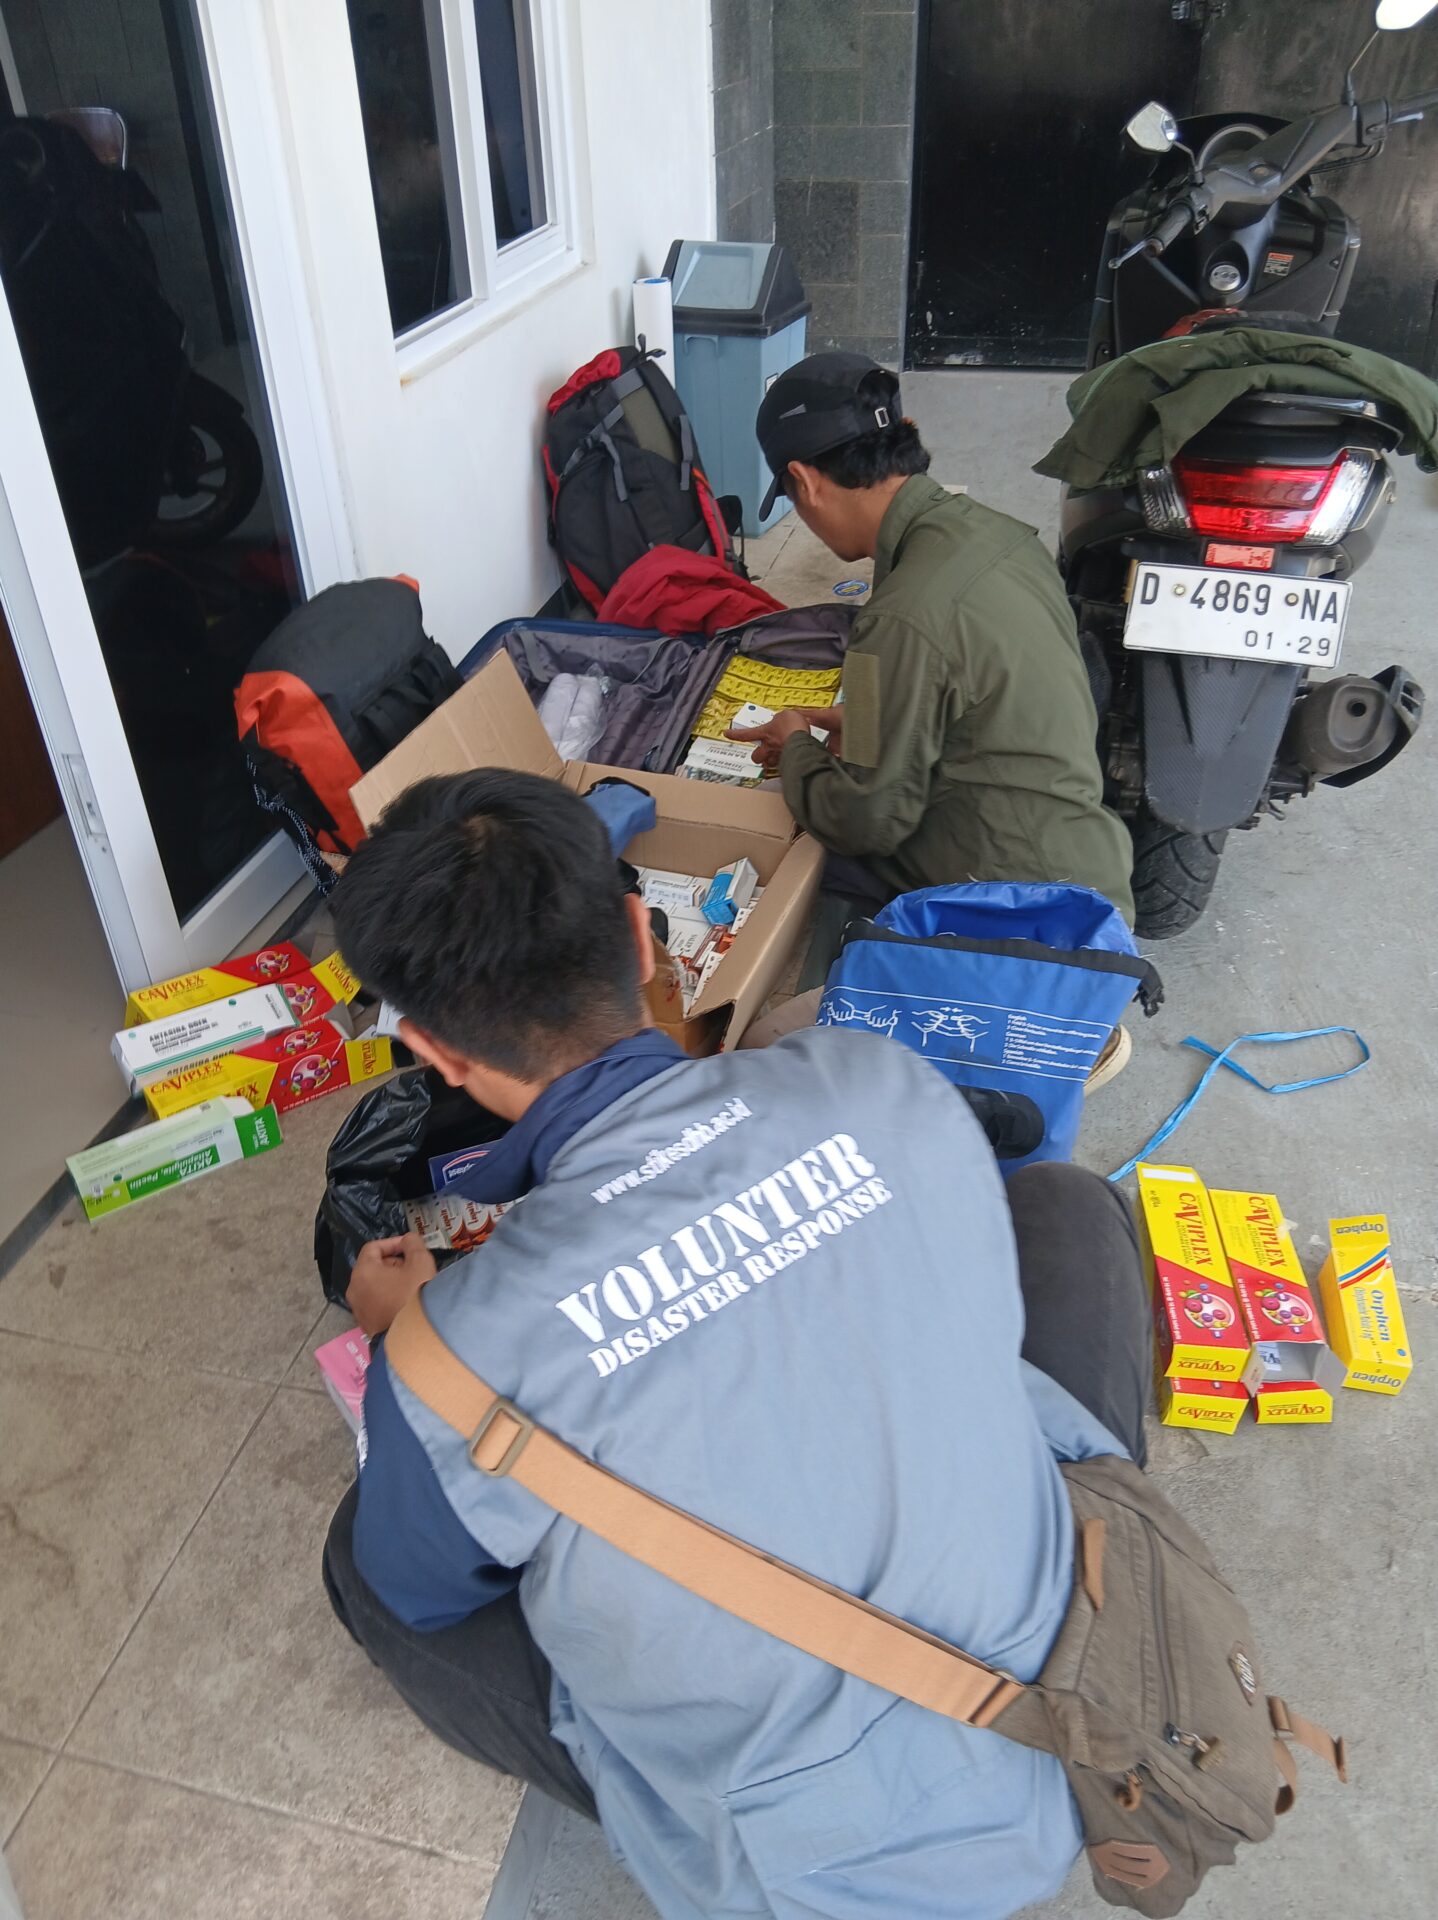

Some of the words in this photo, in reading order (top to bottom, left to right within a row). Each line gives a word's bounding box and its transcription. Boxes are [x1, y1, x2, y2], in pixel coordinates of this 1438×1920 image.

[1139, 571, 1160, 605] D
[1189, 577, 1271, 616] 4869
[1299, 588, 1338, 624] NA
[138, 973, 205, 1001] CAVIPLEX
[150, 1060, 223, 1095] CAVIPLEX
[179, 1153, 213, 1177] AKITA
[554, 1132, 877, 1343] VOLUNTER
[1174, 1191, 1213, 1265] CAVIPLEX
[1245, 1195, 1286, 1267] CAVIPLEX
[1336, 1221, 1384, 1235] Orphen
[587, 1270, 751, 1378] DISASTER
[742, 1176, 894, 1285] RESPONSE
[1371, 1289, 1390, 1341] Orphen
[1177, 1359, 1236, 1373] CAVIPLEX
[1352, 1370, 1402, 1388] Orphen
[1177, 1406, 1235, 1420] CAVIPLEX
[1266, 1403, 1325, 1416] CAVIPLEX
